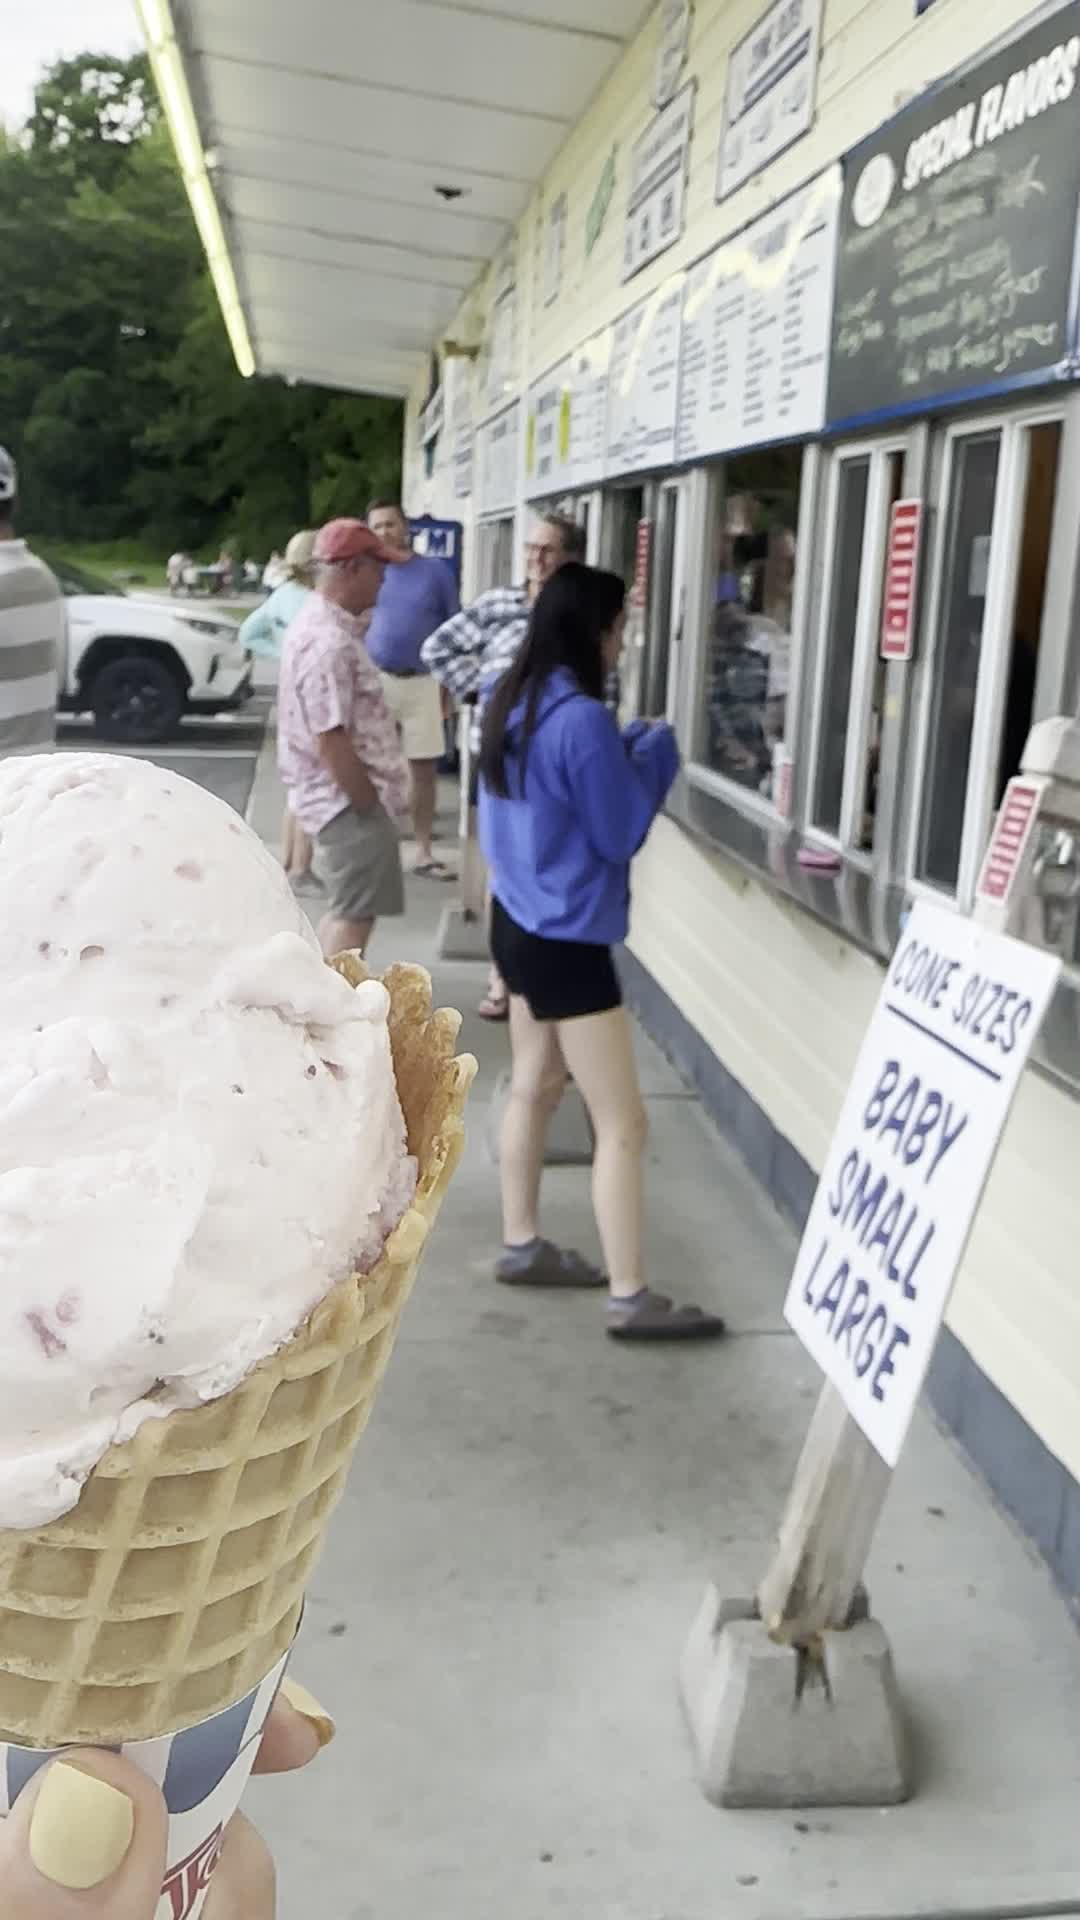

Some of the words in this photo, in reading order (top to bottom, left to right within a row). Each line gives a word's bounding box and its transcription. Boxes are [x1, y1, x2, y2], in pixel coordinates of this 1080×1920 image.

[902, 102, 976, 190] SPECIAL
[974, 36, 1080, 147] FLAVORS
[893, 940, 961, 1008] CONE
[953, 973, 1032, 1053] SIZES
[864, 1060, 968, 1184] BABY
[828, 1148, 936, 1300] SMALL
[803, 1236, 910, 1402] LARGE
